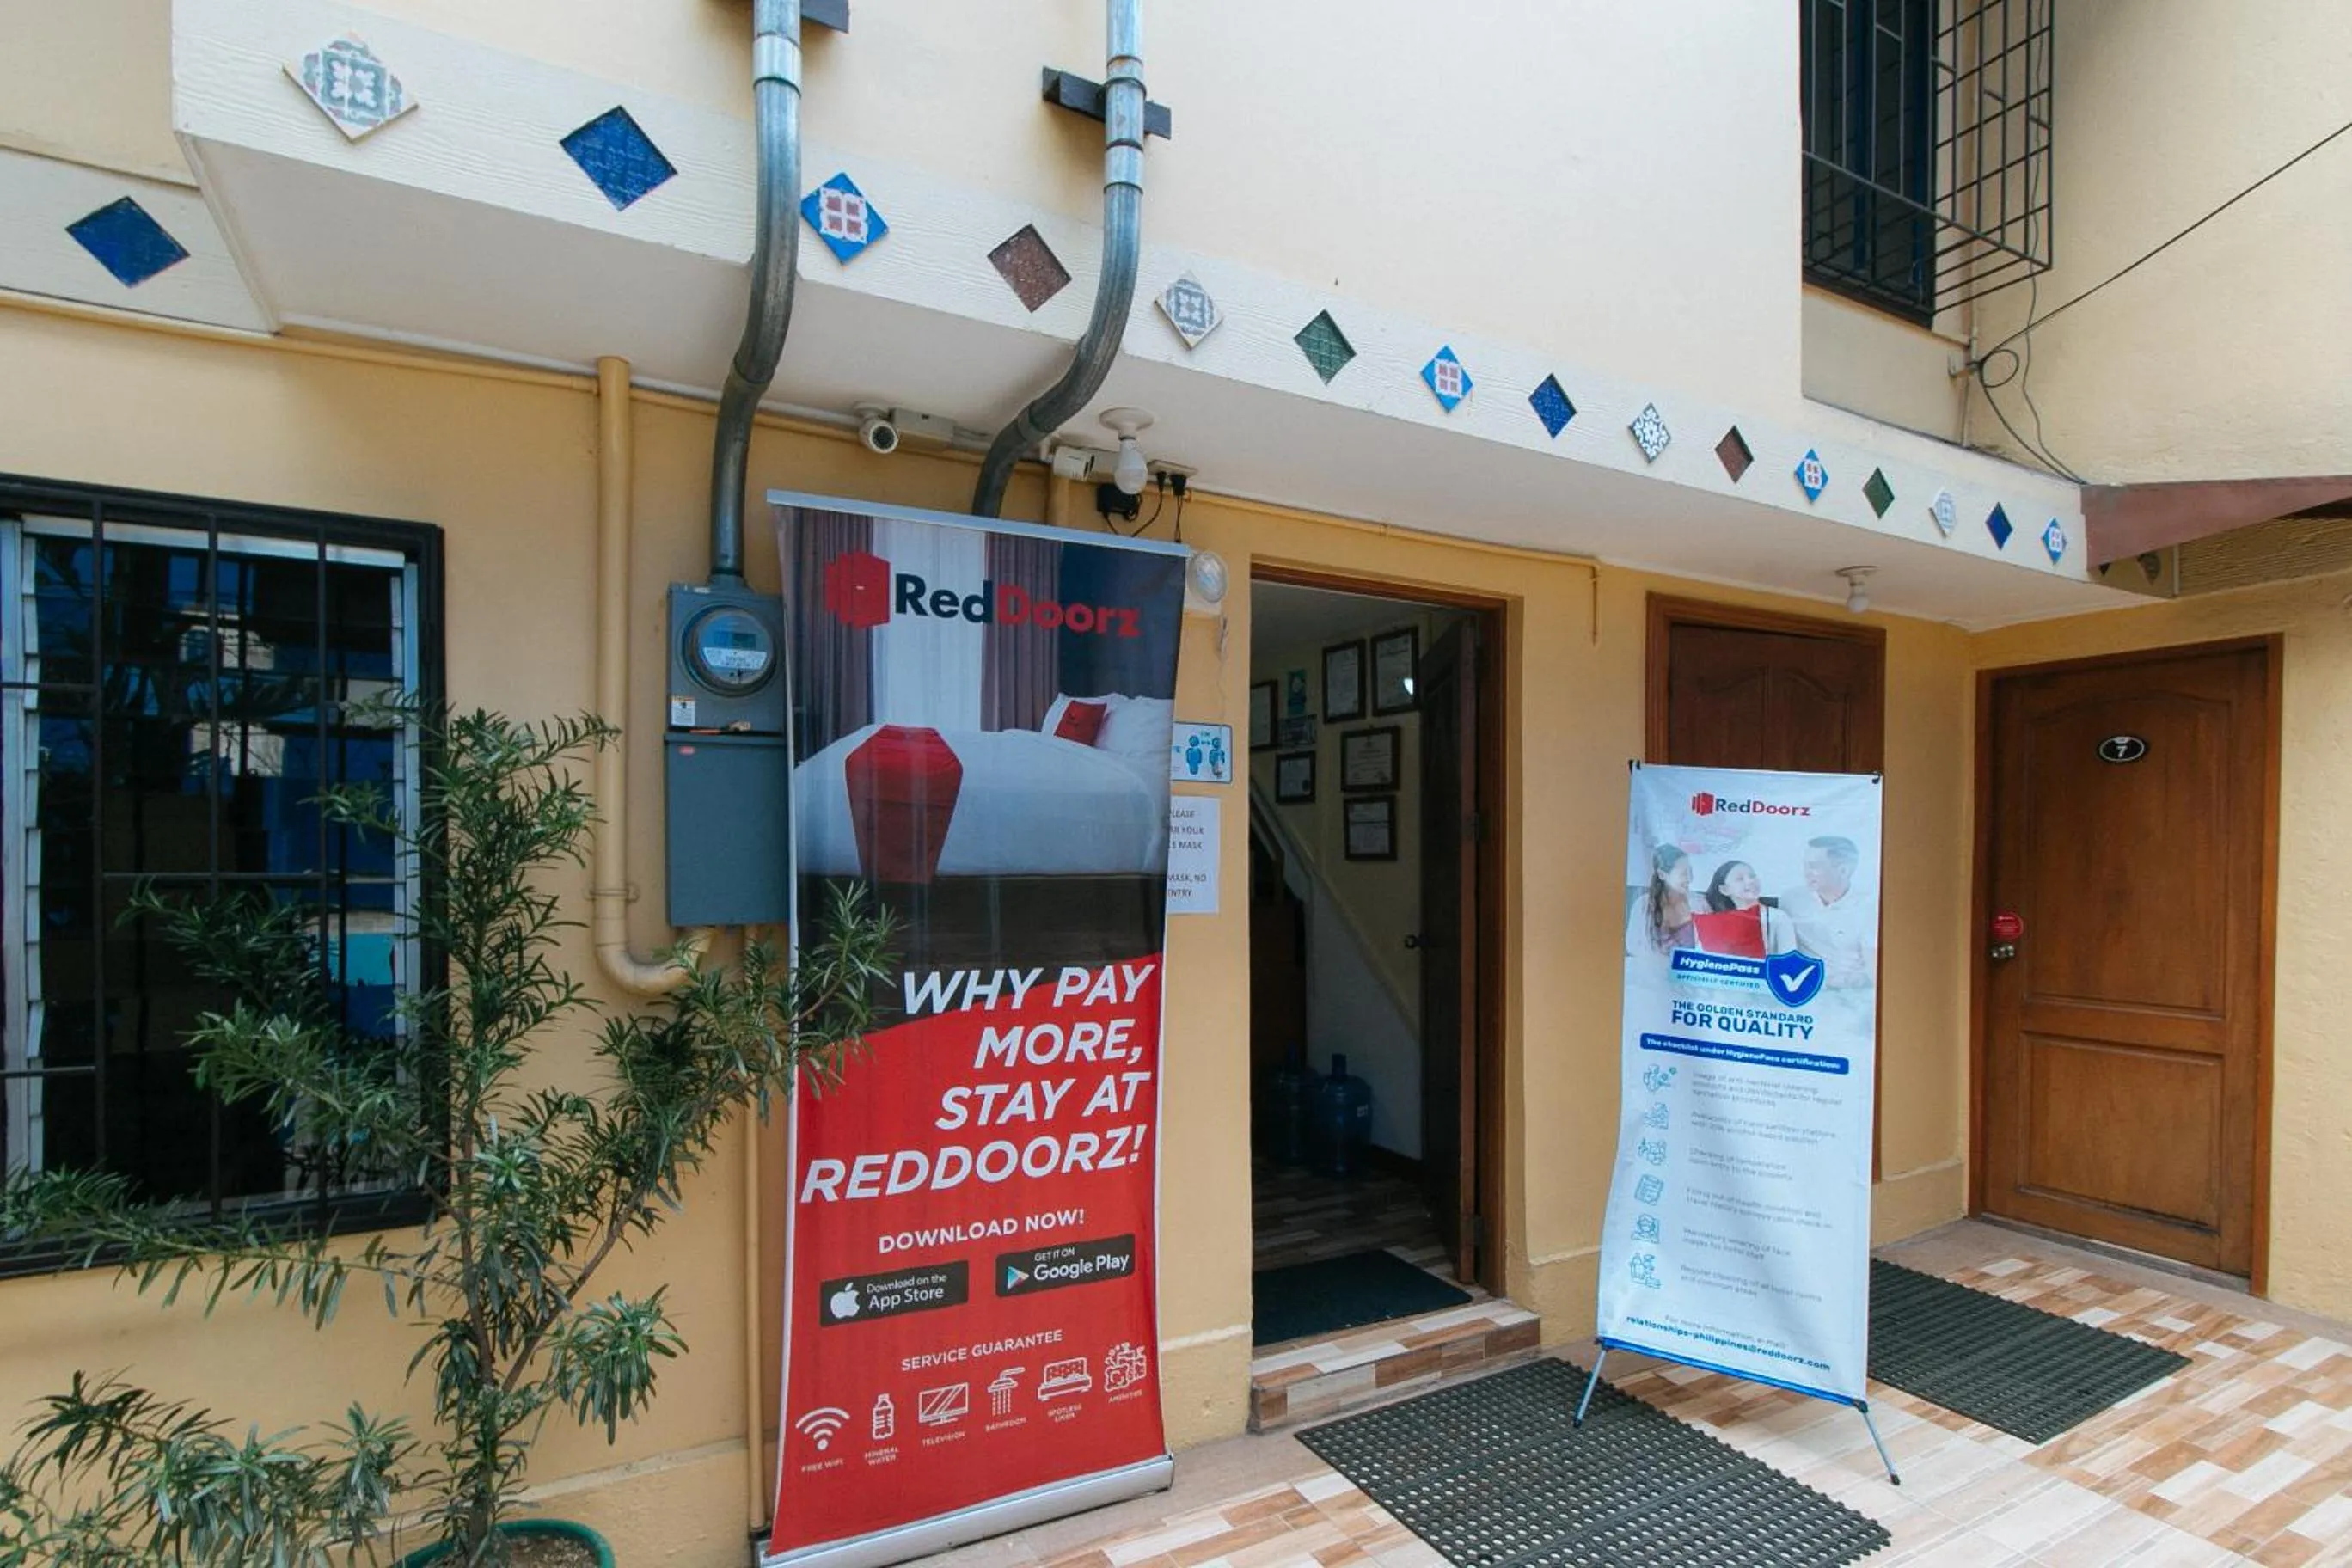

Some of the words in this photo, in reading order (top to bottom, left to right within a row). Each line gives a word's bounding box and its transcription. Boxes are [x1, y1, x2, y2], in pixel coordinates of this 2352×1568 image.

[895, 573, 1141, 637] RedDoorz
[2116, 744, 2128, 757] 7
[1716, 799, 1811, 816] RedDoorz
[1679, 957, 1761, 975] HygienePass
[904, 966, 1043, 1014] WHY
[1053, 964, 1155, 1008] PAY
[1671, 1010, 1712, 1029] FOR
[1718, 1016, 1813, 1040] QUALITY
[1672, 1000, 1695, 1011] THE
[1696, 1001, 1743, 1017] GOLDEN
[1746, 1008, 1813, 1025] STANDARD
[973, 1019, 1142, 1069] MORE,
[935, 1078, 1075, 1130] STAY
[1081, 1072, 1151, 1117] AT
[800, 1124, 1147, 1203] REDDOORZ!
[879, 1217, 1018, 1254] DOWNLOAD
[1025, 1208, 1085, 1232] NOW!
[1034, 1251, 1051, 1262] GET
[1053, 1250, 1059, 1259] IT
[1060, 1246, 1075, 1258] ON
[1034, 1259, 1093, 1280] Google
[1095, 1253, 1130, 1271] Play
[867, 1275, 916, 1294] Download
[931, 1273, 947, 1283] the
[869, 1294, 901, 1311] App
[903, 1287, 944, 1303] Store
[902, 1347, 967, 1372] SERVICE
[971, 1329, 1063, 1357] GUARANTEE
[921, 1430, 965, 1447] TELEVISION
[865, 1446, 898, 1460] MINERAL
[867, 1454, 897, 1466] WATER
